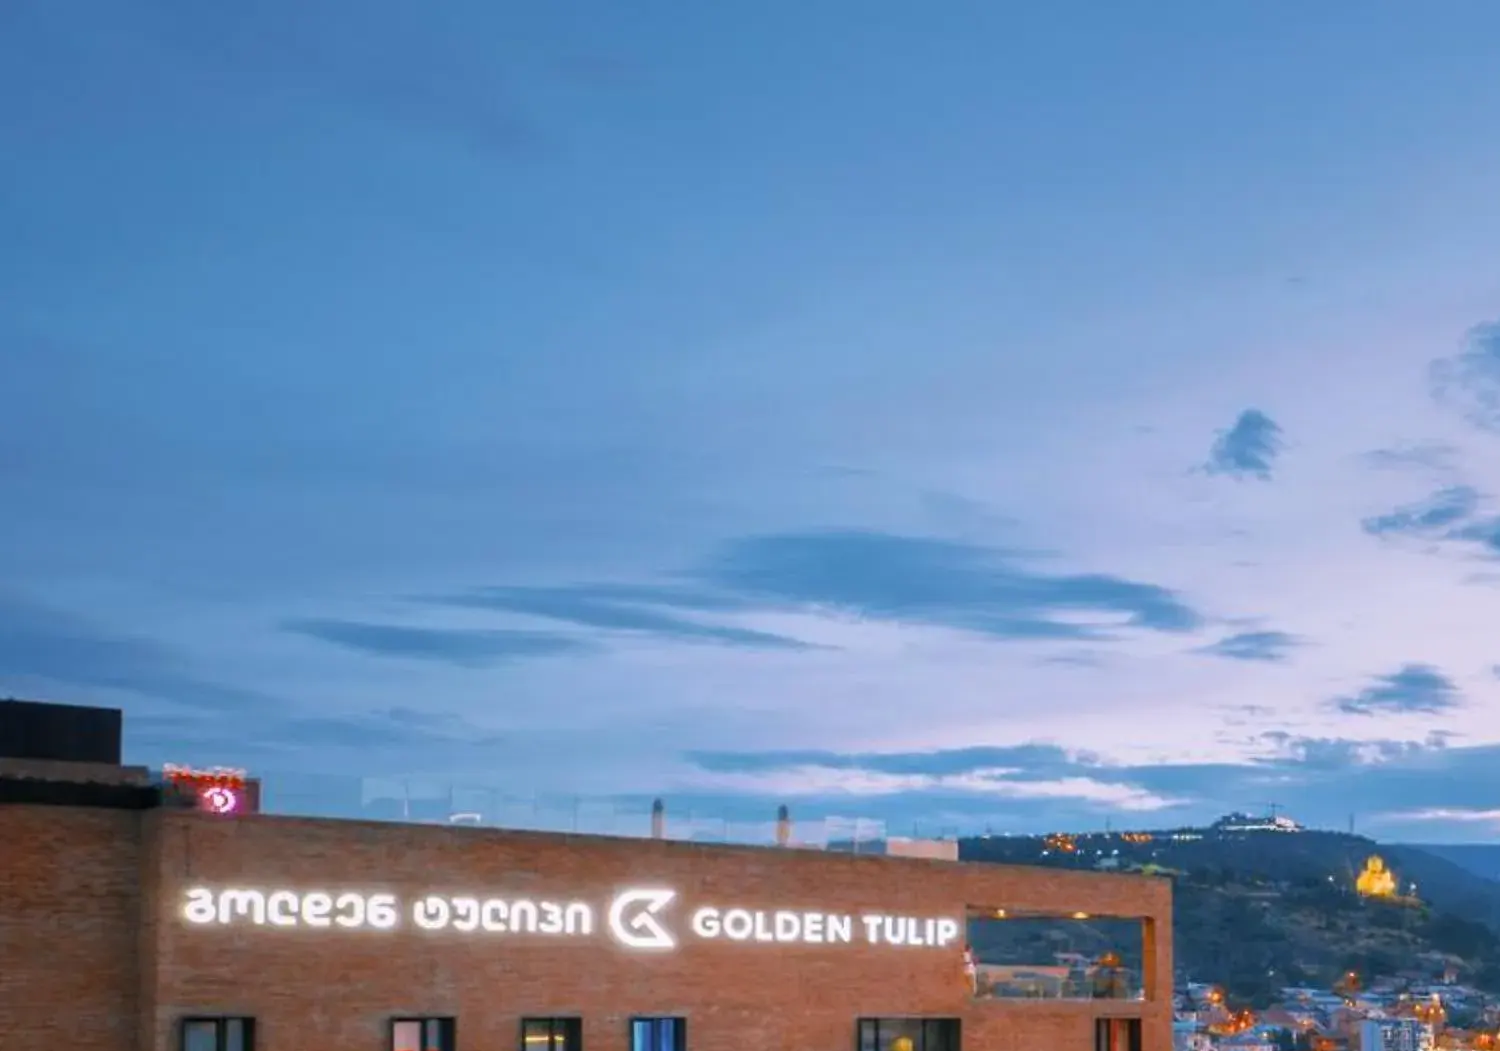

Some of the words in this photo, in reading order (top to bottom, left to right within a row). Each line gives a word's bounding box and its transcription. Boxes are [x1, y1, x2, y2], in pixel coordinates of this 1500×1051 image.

[184, 888, 397, 928] გოლდენ
[693, 907, 851, 943] GOLDEN
[862, 915, 958, 946] TULIP
